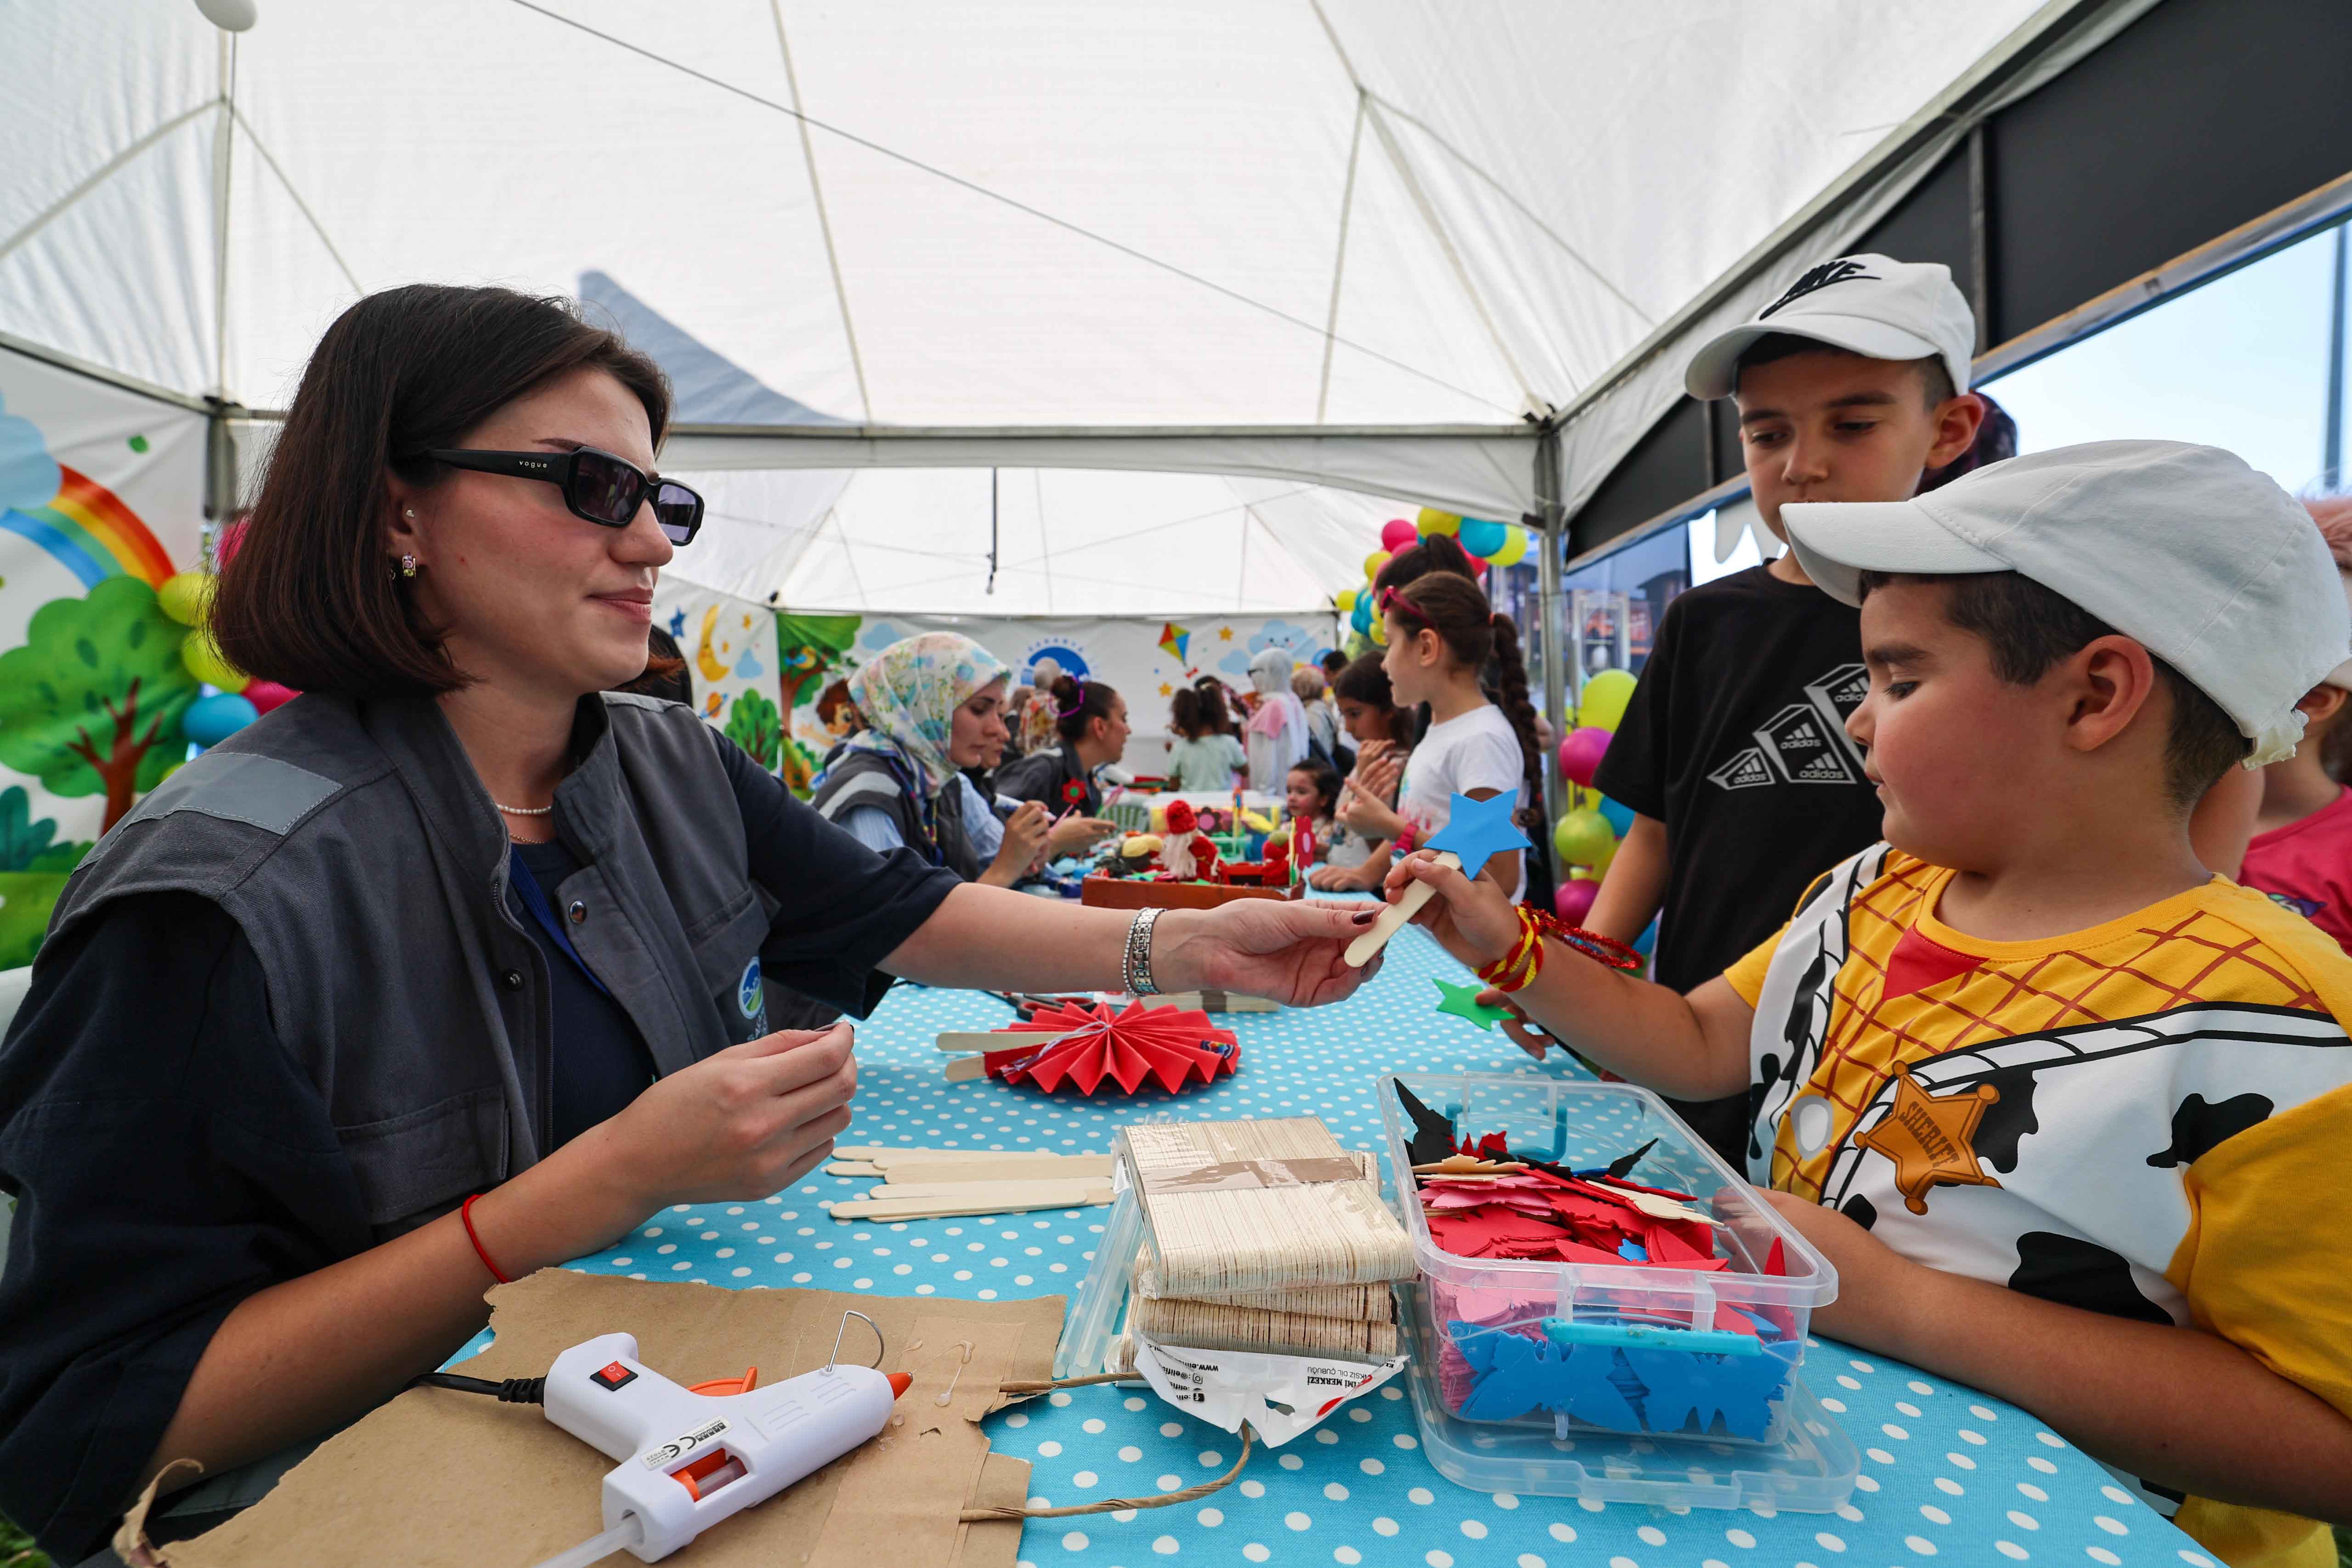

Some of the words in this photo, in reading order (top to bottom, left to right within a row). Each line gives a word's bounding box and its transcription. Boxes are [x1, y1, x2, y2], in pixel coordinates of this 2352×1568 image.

[1781, 739, 1821, 749] adidas
[1733, 772, 1767, 783] adidas
[1799, 768, 1844, 779] adidas
[1898, 1101, 1960, 1168] SHERIFF
[1307, 1366, 1336, 1376] ÇUBUĞU
[1307, 1376, 1343, 1386] MERKEZİ
